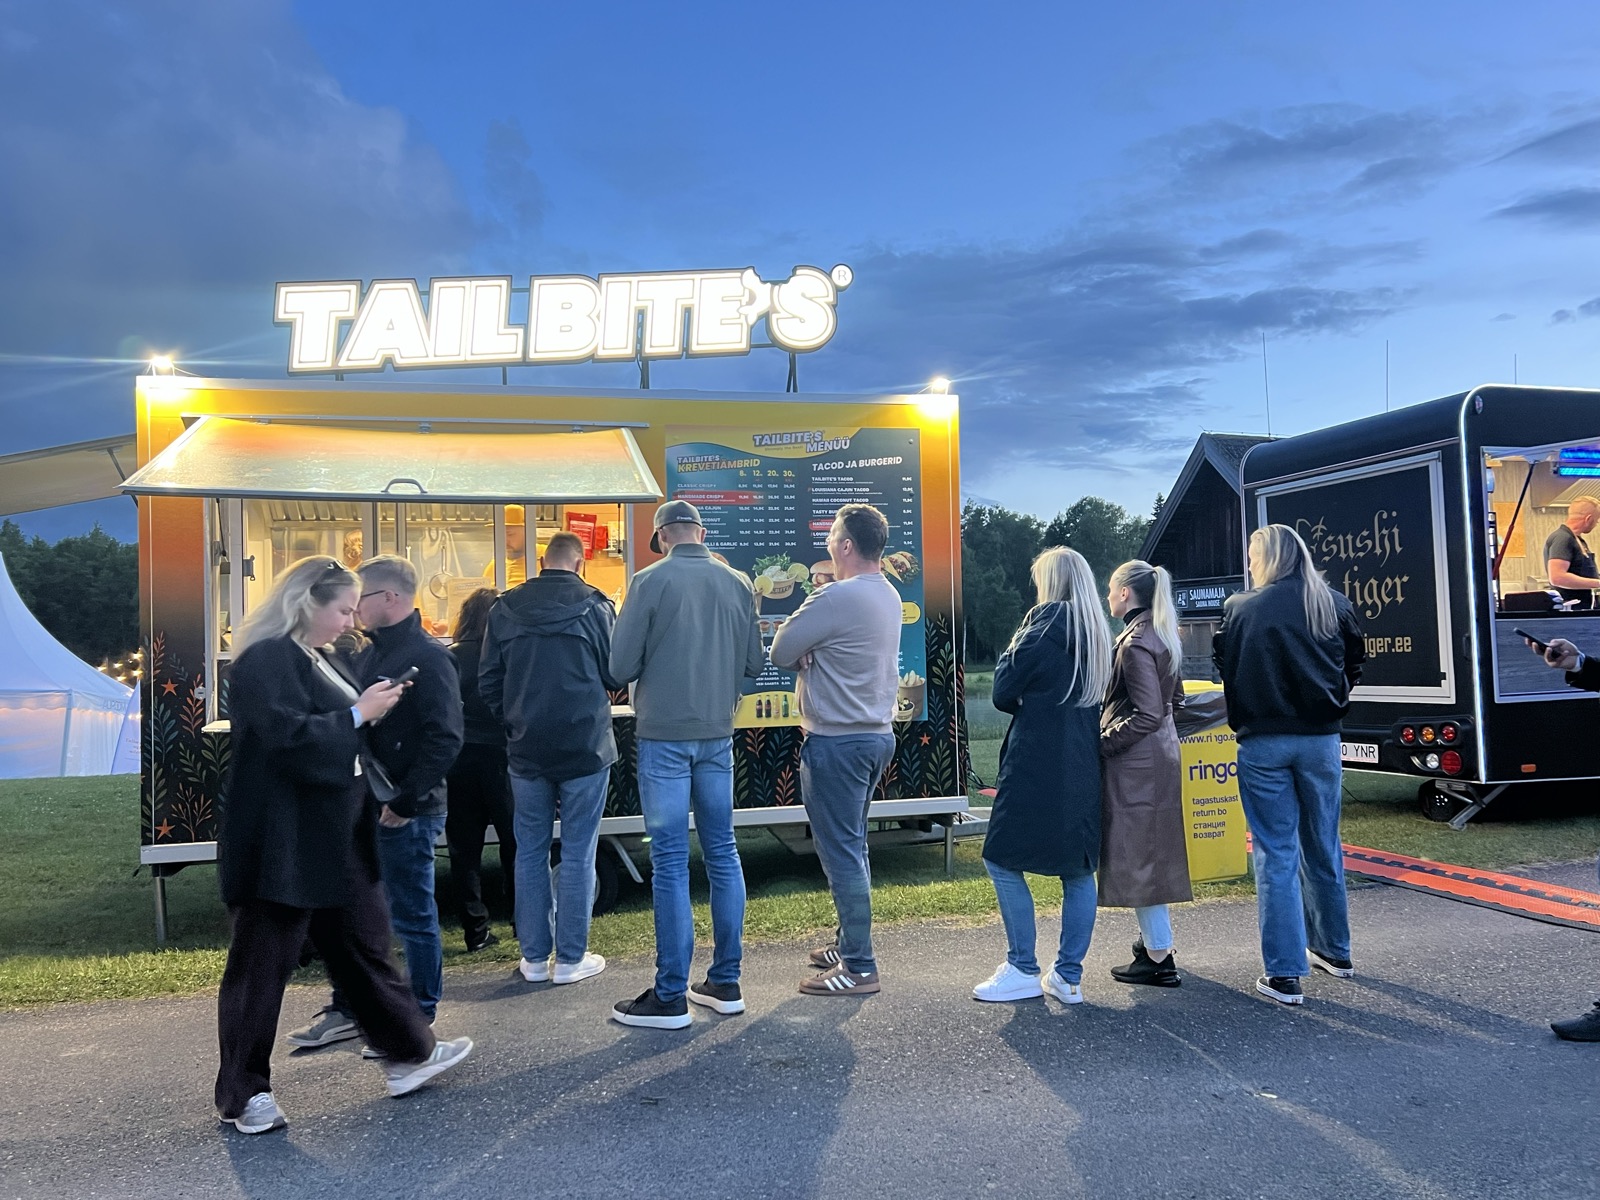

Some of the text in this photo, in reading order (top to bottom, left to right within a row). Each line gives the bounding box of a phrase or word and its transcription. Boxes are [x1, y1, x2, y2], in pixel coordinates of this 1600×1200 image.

[806, 437, 850, 453] MENÜÜ
[812, 456, 902, 471] TACOD JA BURGERID
[1321, 510, 1403, 567] sushi
[1190, 587, 1226, 600] SAUNAMAJA
[1343, 566, 1409, 619] tiger
[1364, 633, 1412, 658] iger.ee
[1180, 733, 1236, 744] www.ringo.e
[1354, 745, 1376, 758] YNR
[1189, 760, 1238, 784] ringo
[1192, 795, 1238, 806] tagastuskast
[1193, 809, 1216, 817] return
[1193, 821, 1226, 830] станция
[1193, 830, 1225, 839] возврат
